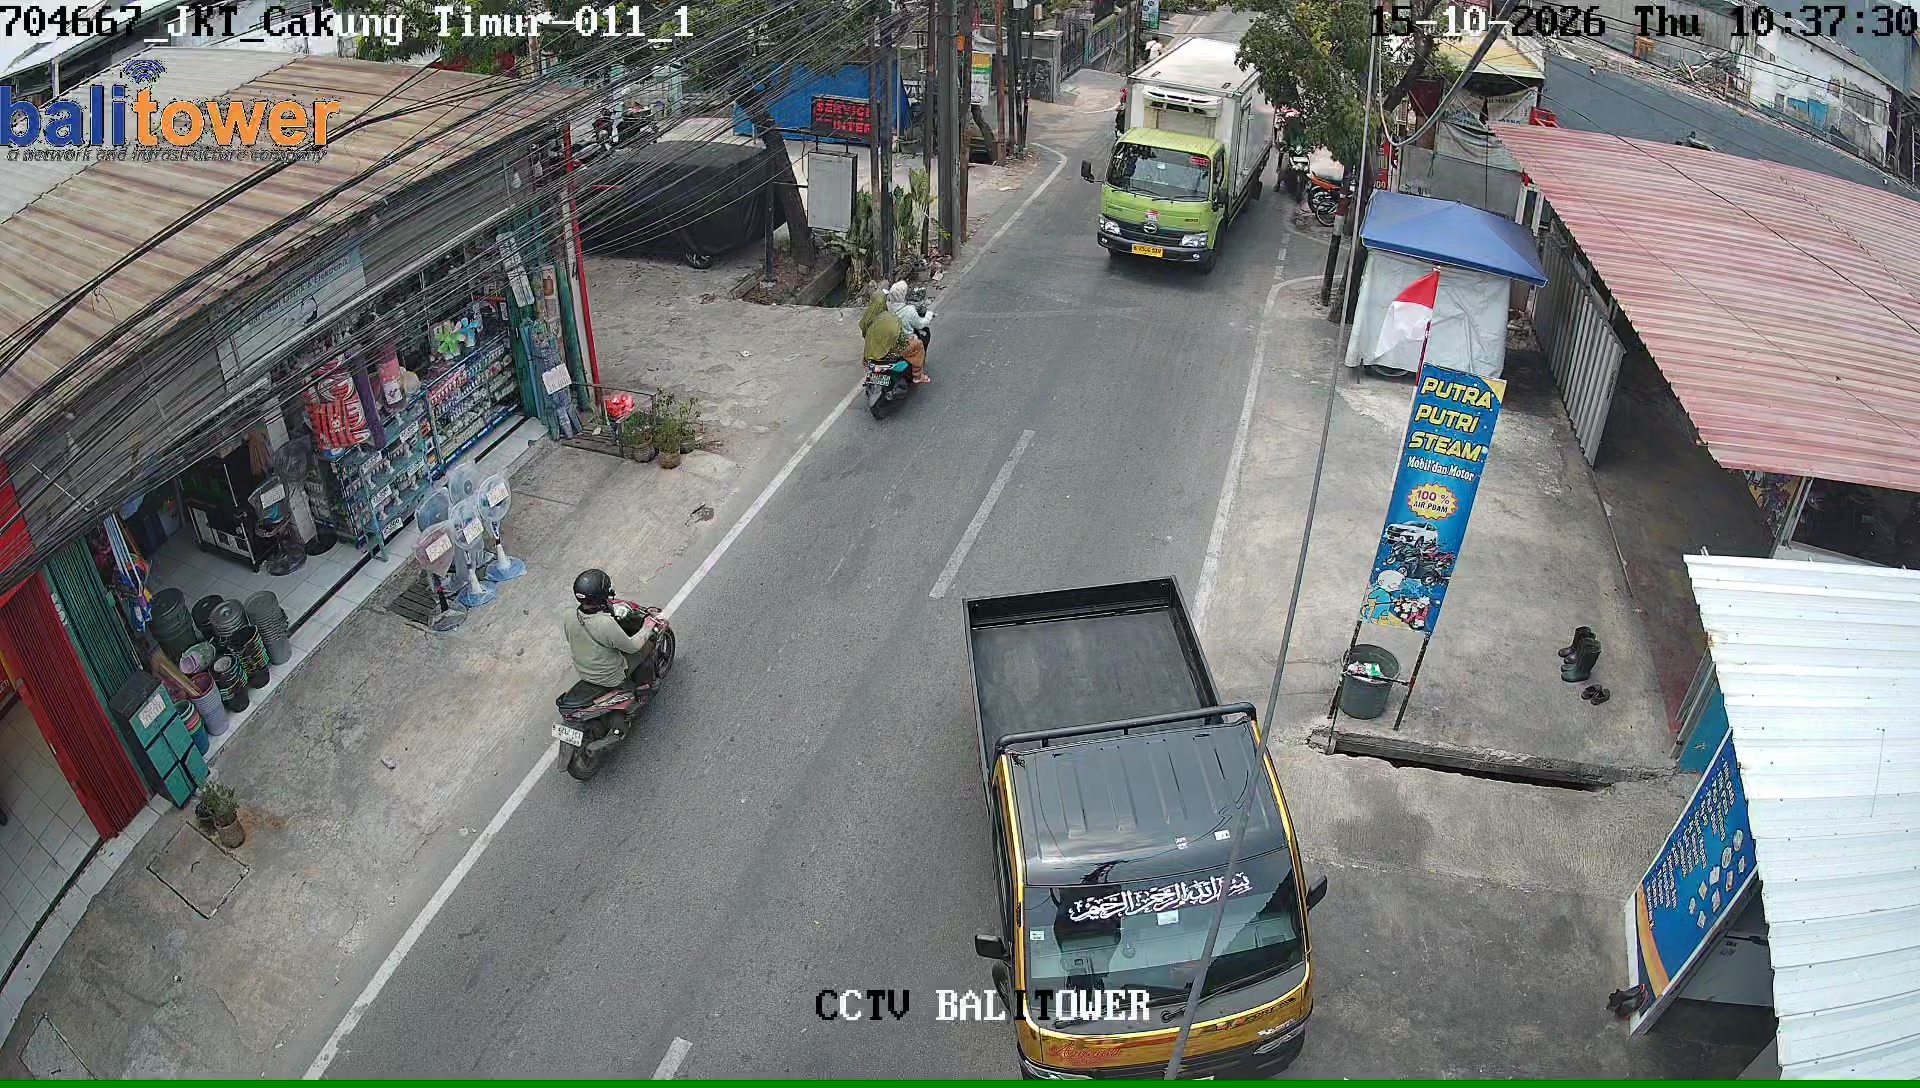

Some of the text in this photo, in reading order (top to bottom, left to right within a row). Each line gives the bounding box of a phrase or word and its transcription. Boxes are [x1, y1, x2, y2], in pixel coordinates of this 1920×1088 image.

[1419, 376, 1492, 410] PUTRA
[1414, 403, 1480, 434] PUTRI
[1408, 430, 1483, 462] STEAM
[1407, 455, 1475, 482] Mobil dan Motor
[1413, 500, 1448, 514] AIR PDAM
[1416, 490, 1450, 505] 100 %
